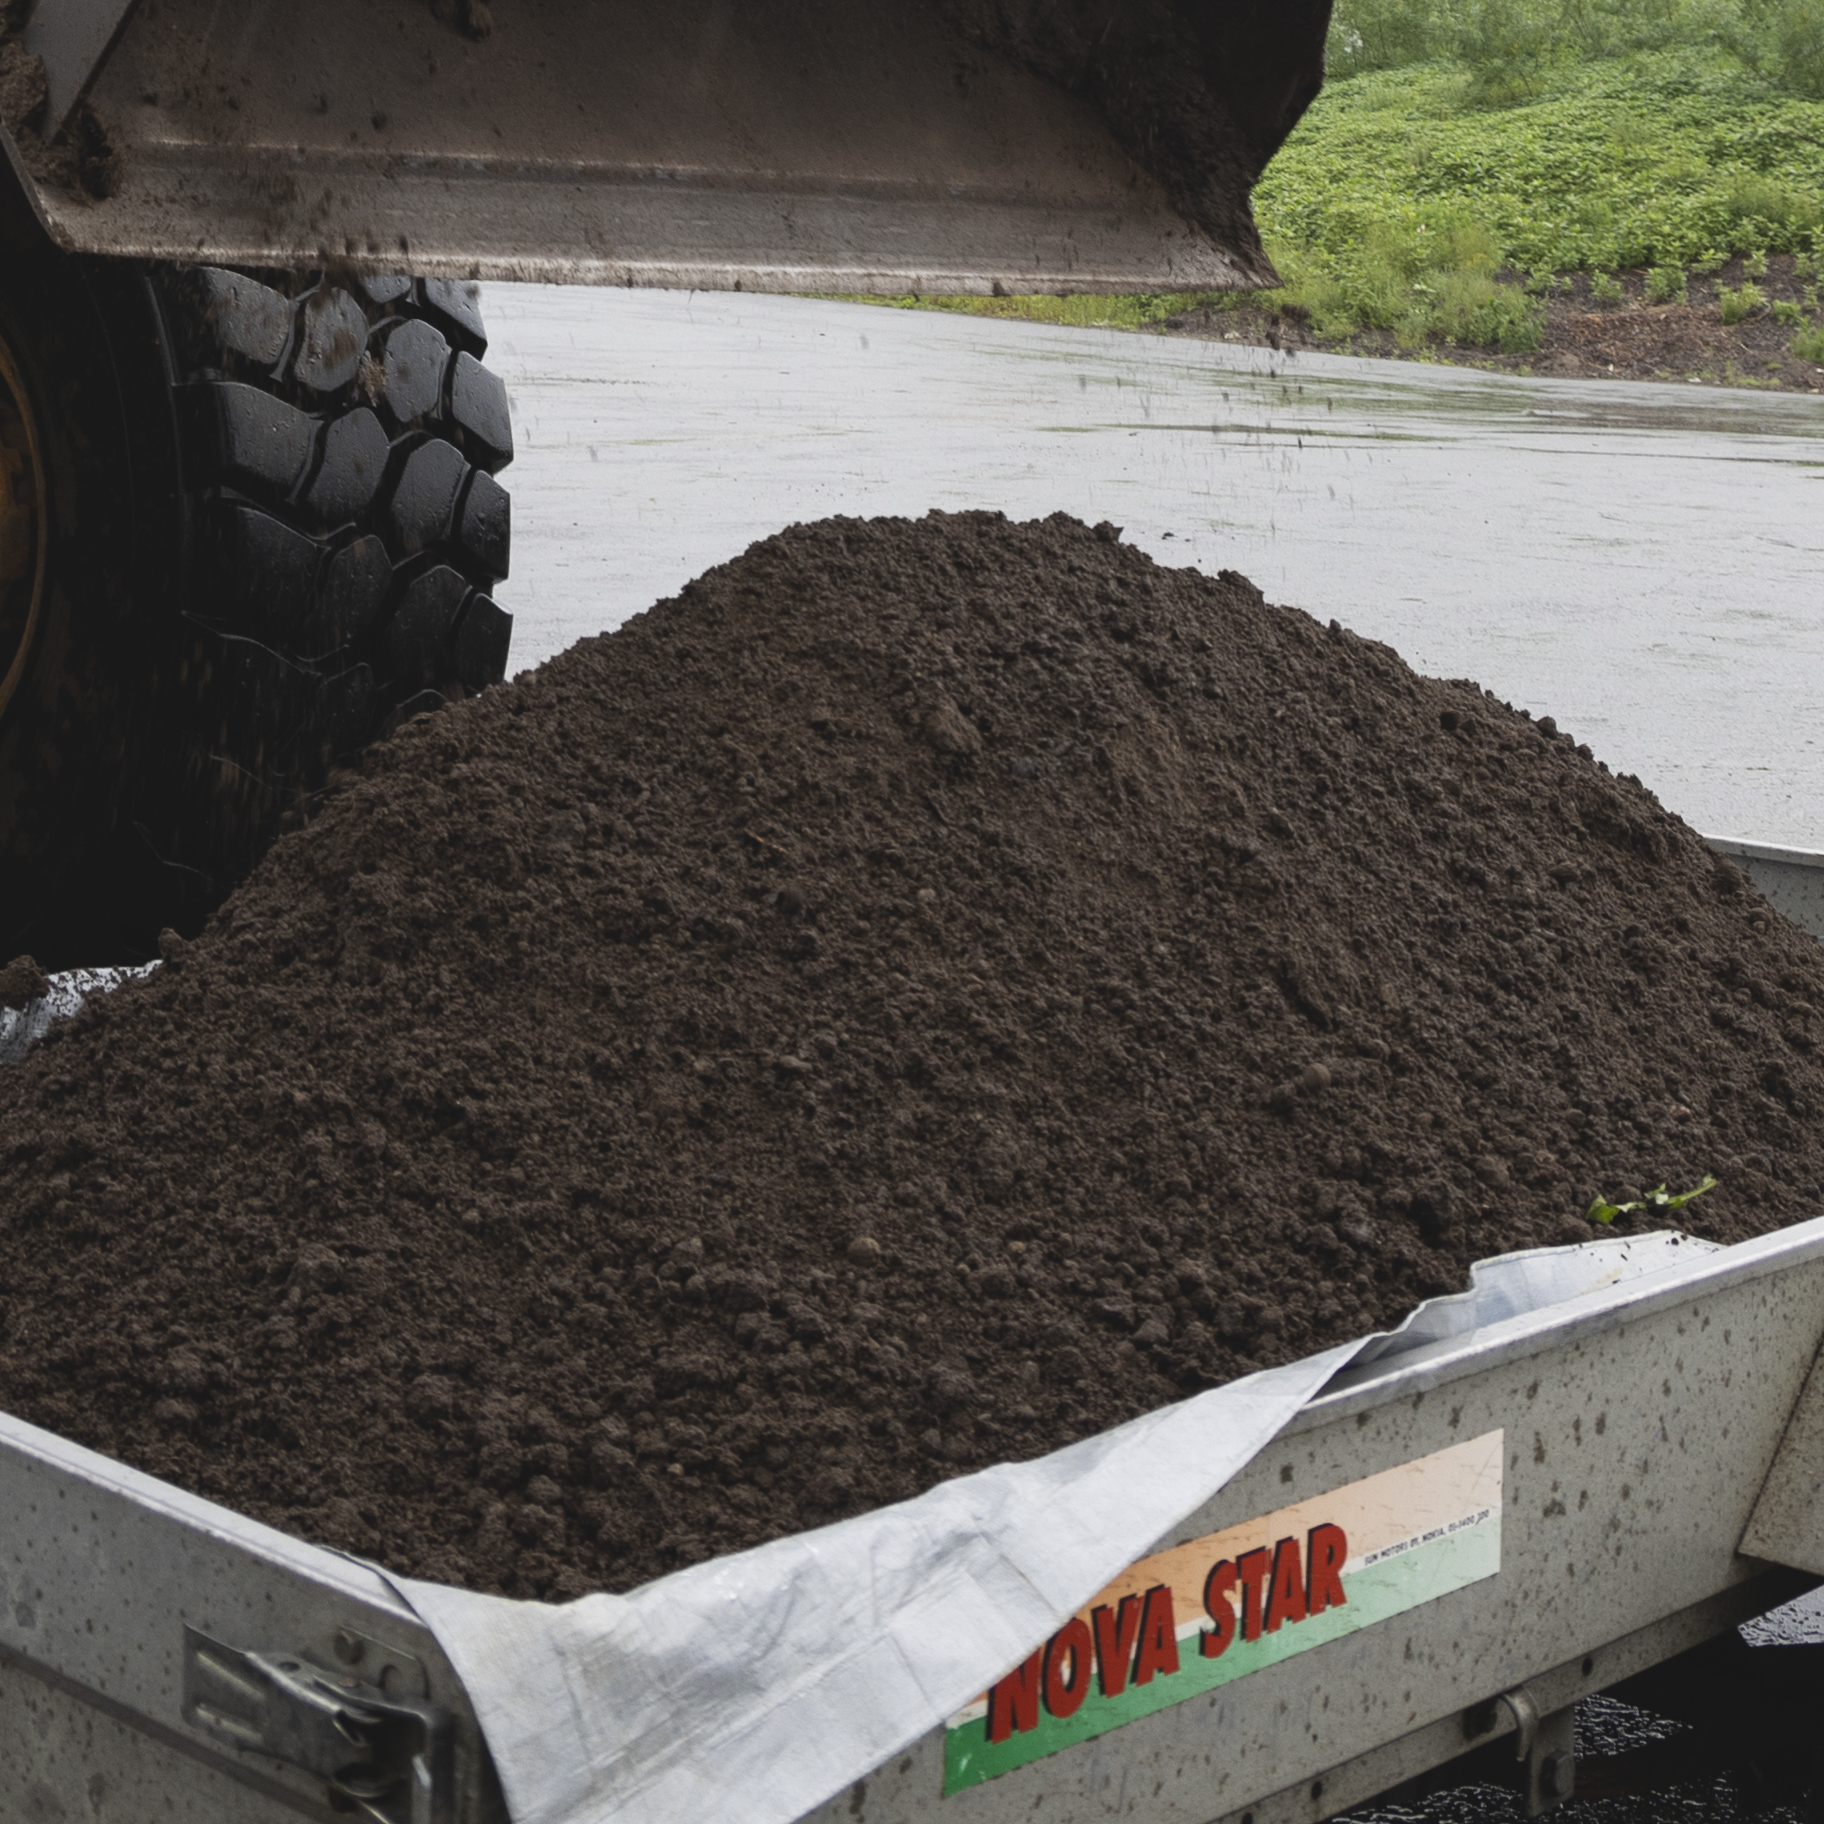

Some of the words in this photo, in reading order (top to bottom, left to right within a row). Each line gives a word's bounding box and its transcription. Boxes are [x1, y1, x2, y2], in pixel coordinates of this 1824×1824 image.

[1380, 1541, 1409, 1557] MOTORS
[984, 1583, 1181, 1745] NOVA
[1198, 1521, 1348, 1660] STAR
